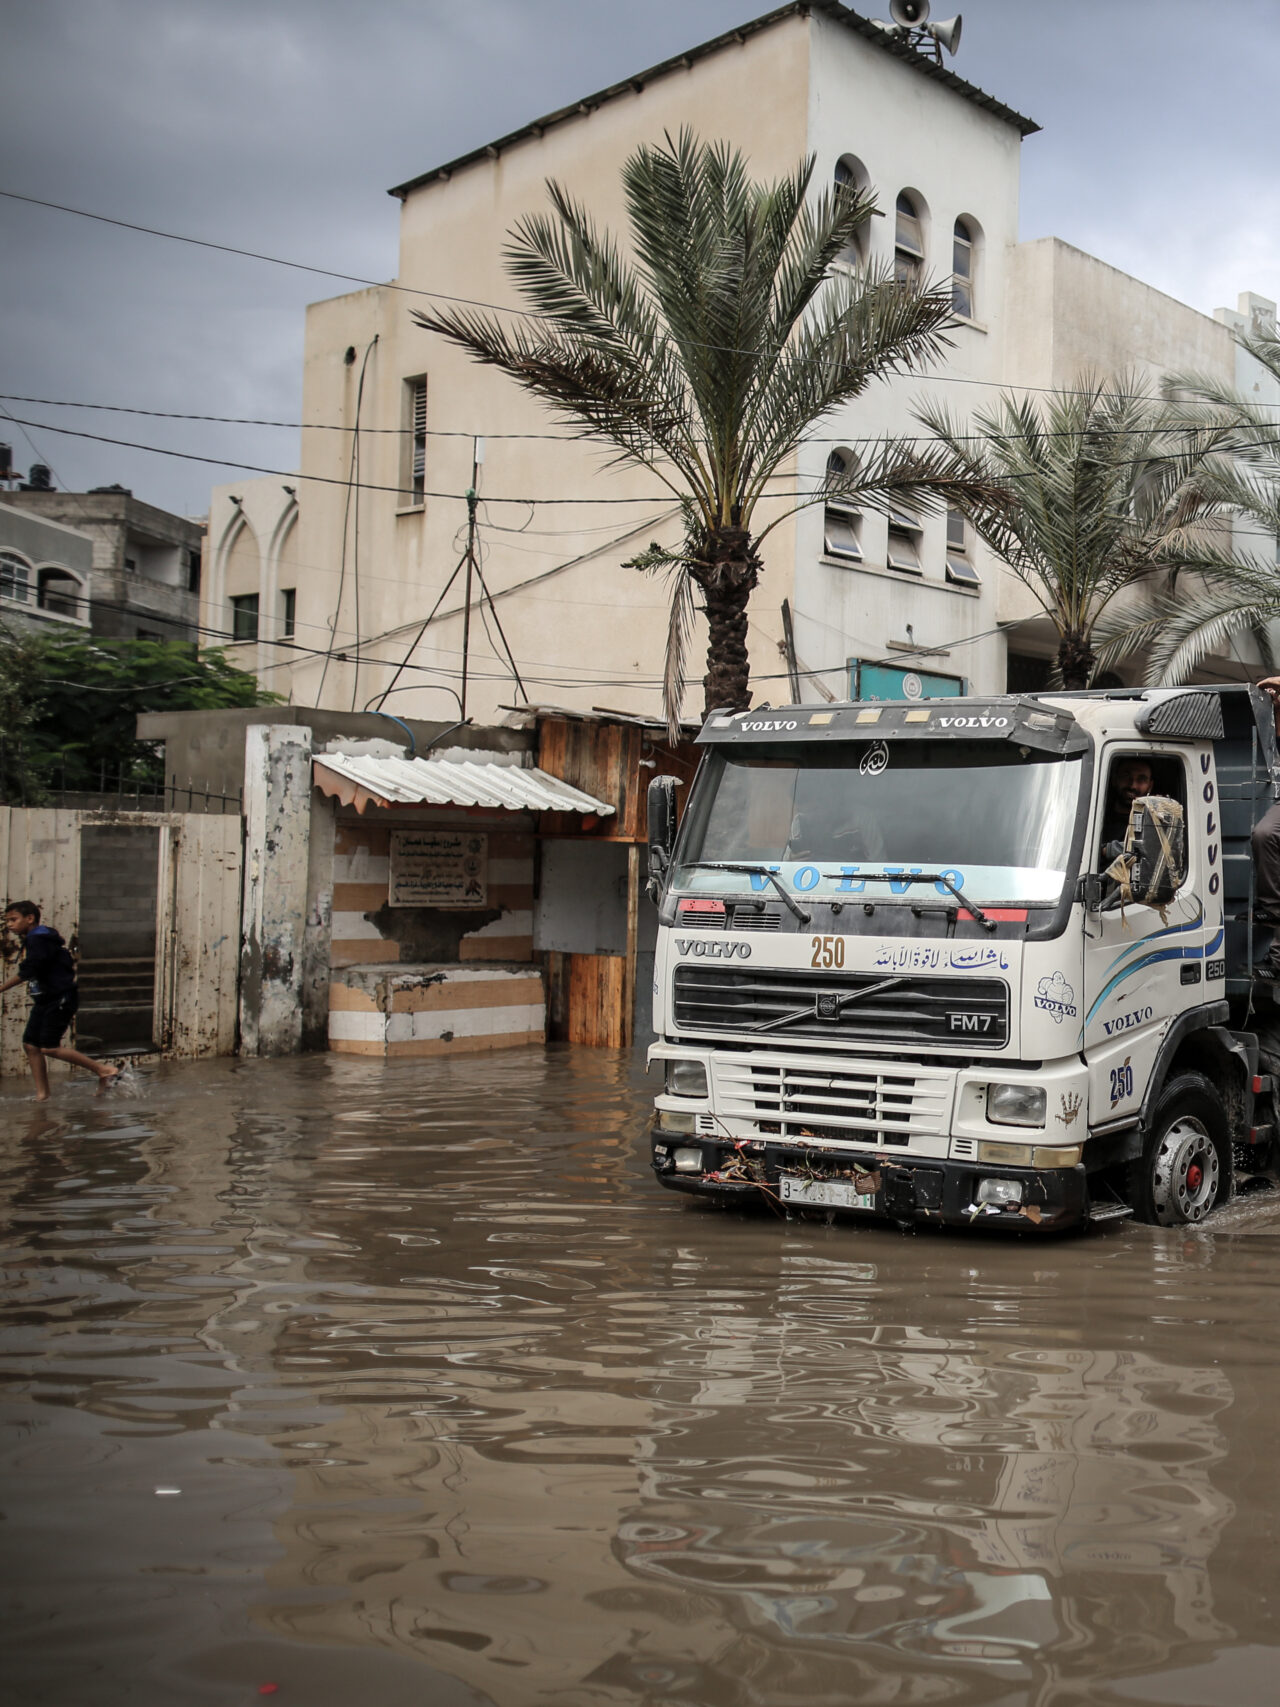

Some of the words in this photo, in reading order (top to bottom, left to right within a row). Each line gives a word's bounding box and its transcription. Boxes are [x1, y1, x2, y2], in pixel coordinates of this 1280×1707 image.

[740, 720, 797, 731] VOLVO
[939, 716, 1008, 728] VOLVO
[1201, 753, 1220, 895] VOLVO
[749, 866, 965, 896] VOLVO
[674, 938, 752, 958] VOLVO
[811, 936, 845, 968] 250
[1208, 961, 1225, 978] 250
[1036, 998, 1076, 1016] VOLVO
[950, 1015, 992, 1031] FM7
[1103, 1006, 1153, 1035] VOLVO
[1110, 1065, 1133, 1102] 250
